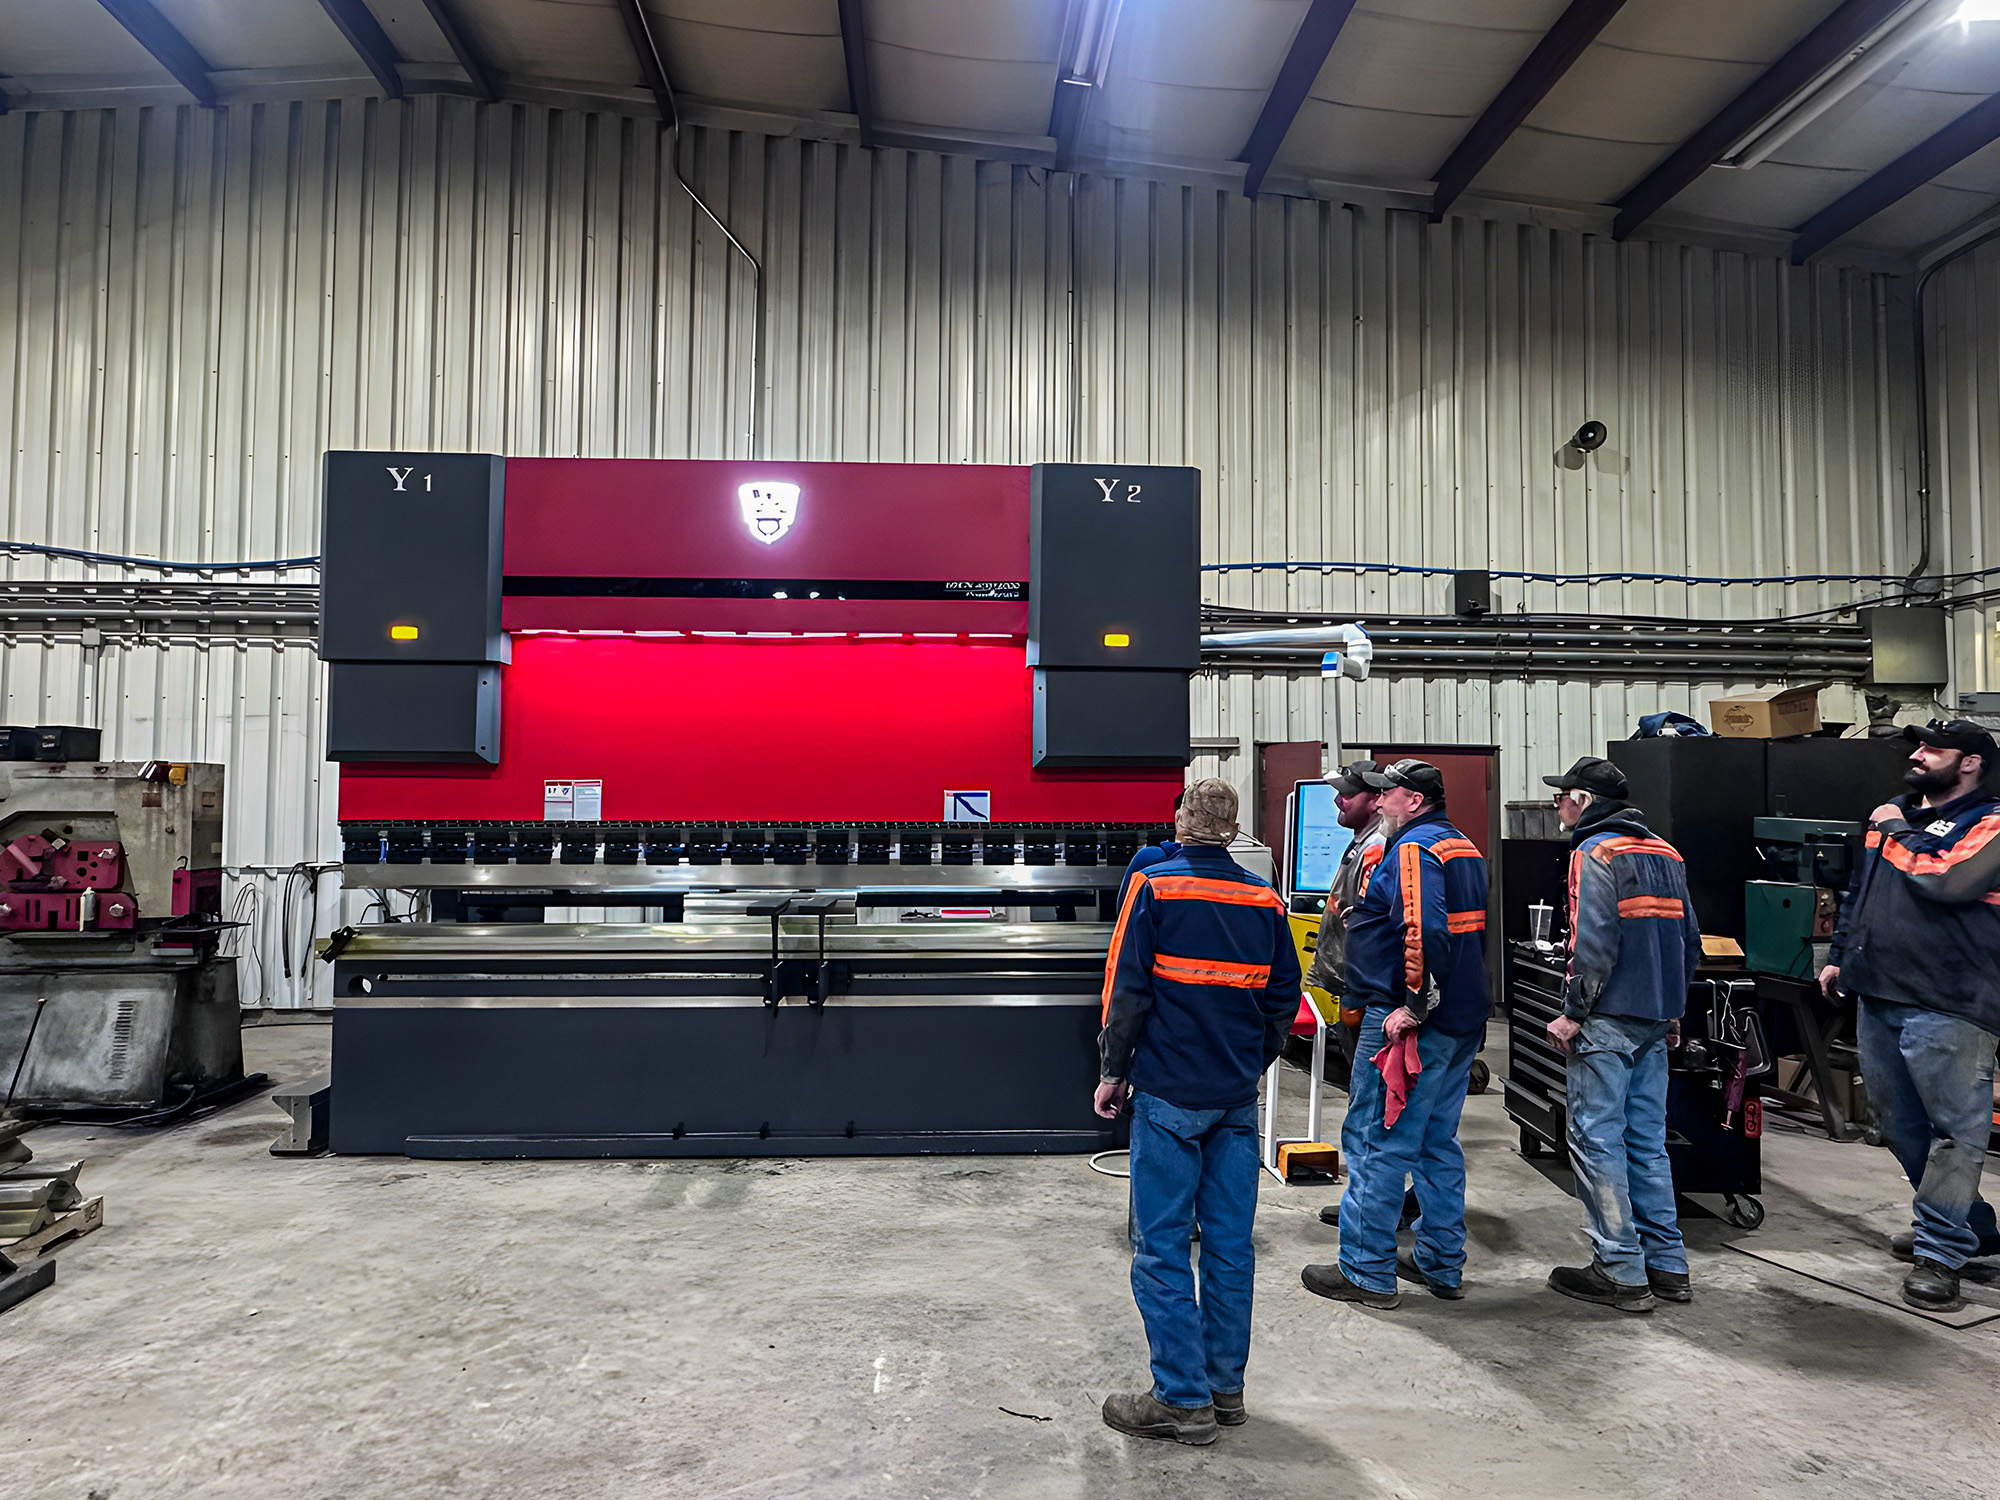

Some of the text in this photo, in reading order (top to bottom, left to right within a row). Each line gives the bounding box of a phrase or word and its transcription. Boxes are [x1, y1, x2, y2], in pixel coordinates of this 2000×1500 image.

[386, 467, 432, 492] Y 1
[1093, 478, 1142, 503] Y 2
